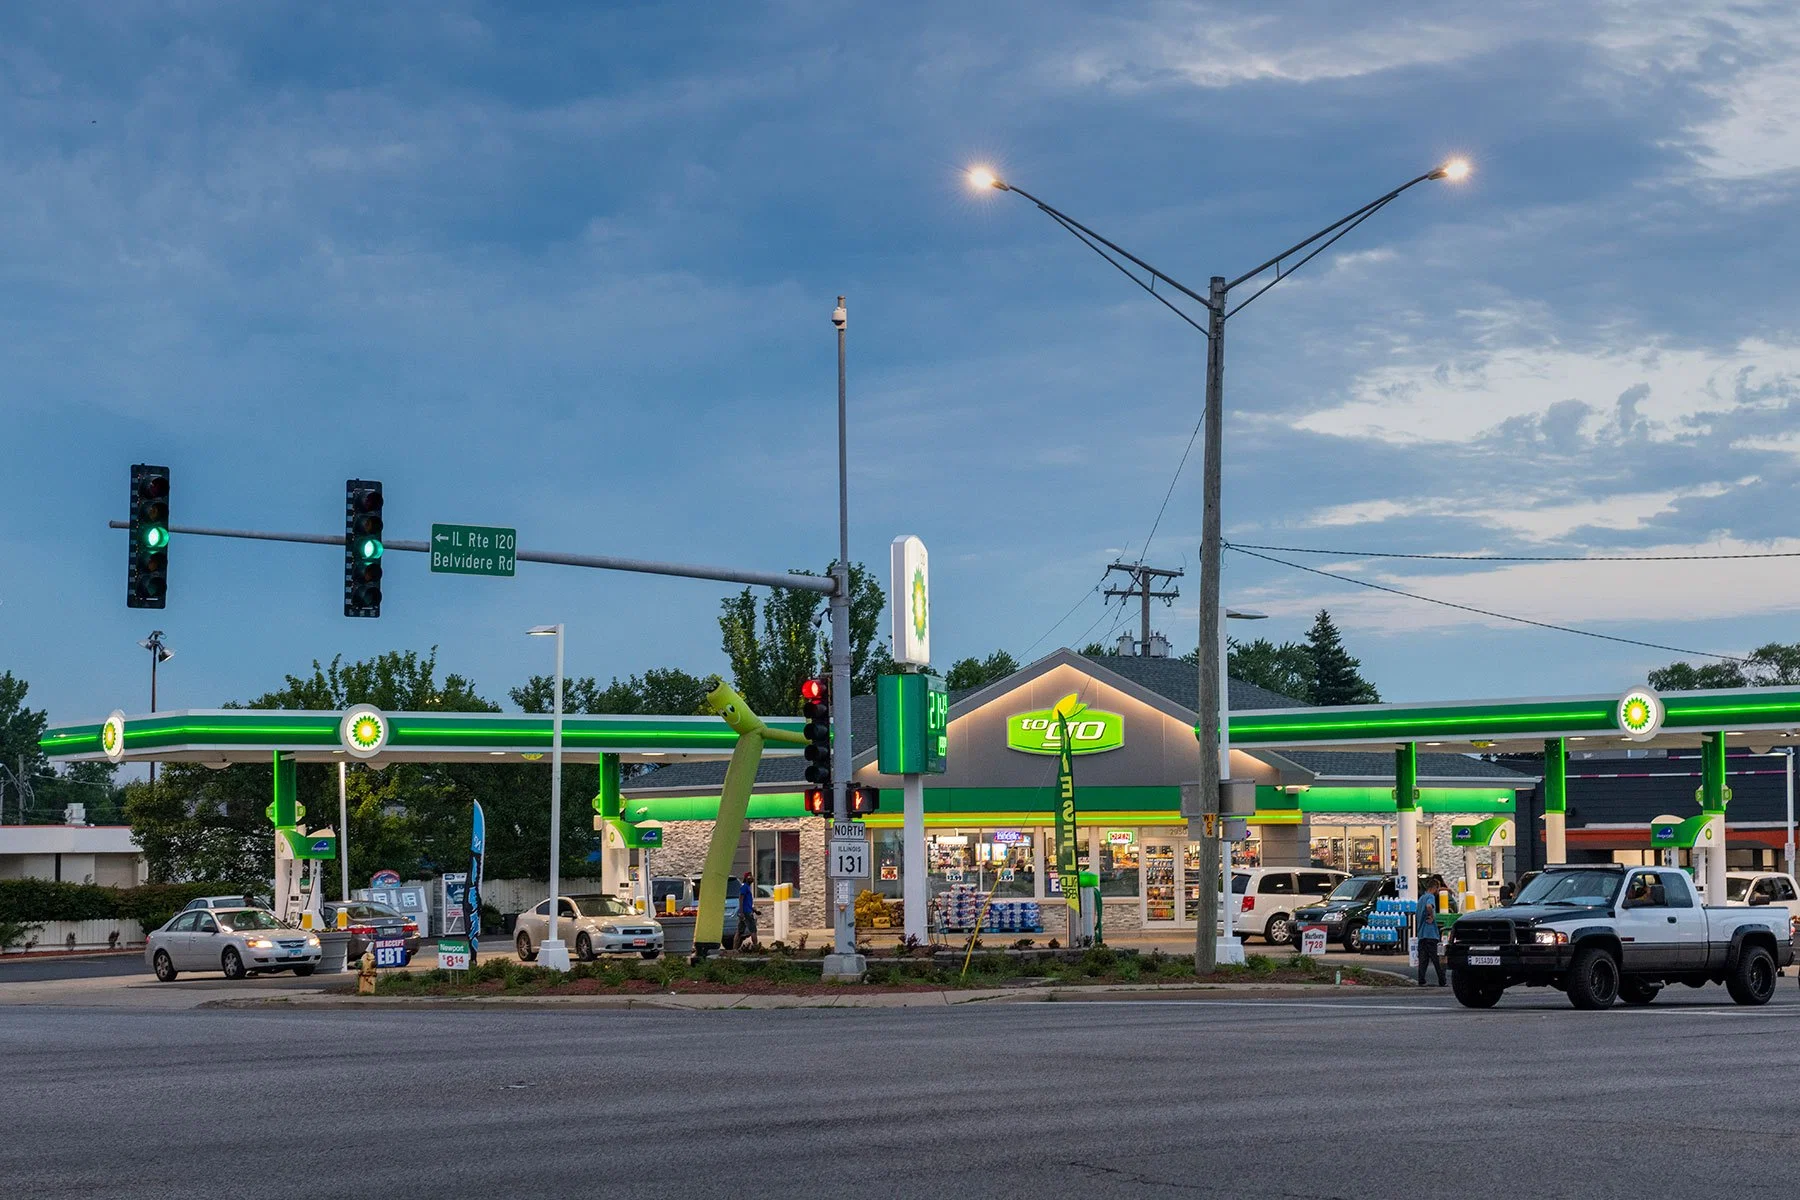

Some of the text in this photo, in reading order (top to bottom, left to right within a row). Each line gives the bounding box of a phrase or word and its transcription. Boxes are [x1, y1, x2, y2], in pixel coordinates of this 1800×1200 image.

[452, 531, 514, 550] IL Rte 120
[433, 551, 514, 571] Belvidere Rd
[1022, 718, 1049, 730] to
[834, 825, 864, 836] NORTH
[1110, 833, 1130, 841] OPEN
[838, 855, 862, 873] 131
[1304, 932, 1325, 940] Marlboro
[375, 939, 404, 948] WE ACCEPT
[439, 943, 465, 952] Newport
[377, 947, 404, 965] EBT
